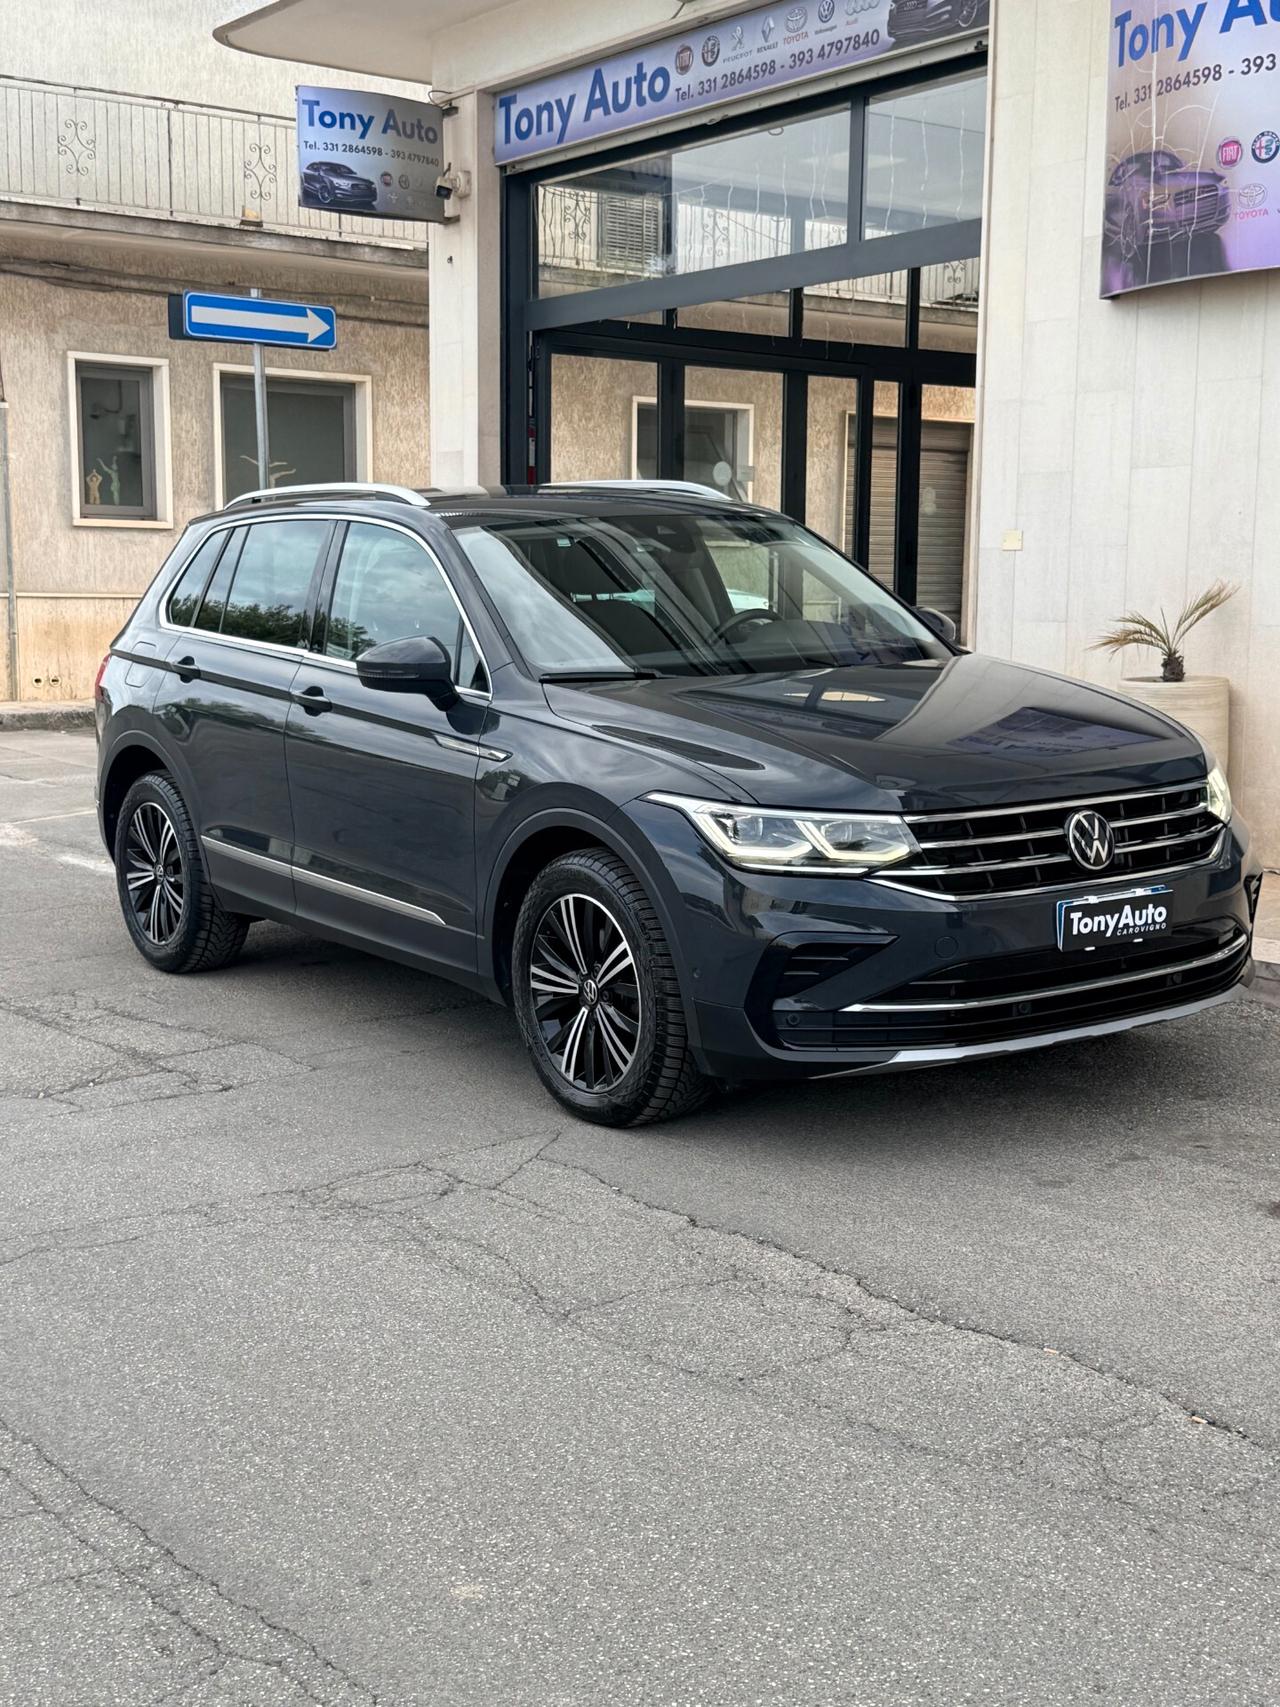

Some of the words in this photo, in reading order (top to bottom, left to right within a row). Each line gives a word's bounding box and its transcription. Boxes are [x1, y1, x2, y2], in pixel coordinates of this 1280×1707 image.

[783, 32, 809, 45] TOYOTA
[1114, 2, 1208, 68] Tony
[1219, 0, 1280, 34] A
[675, 85, 694, 102] Tel.
[698, 79, 717, 97] 331
[721, 60, 776, 89] 2864598
[789, 48, 813, 70] 393
[816, 29, 880, 60] 4797840
[1114, 91, 1131, 113] Tel.
[1134, 83, 1152, 105] 331
[1156, 64, 1222, 97] 2864598
[1241, 53, 1277, 76] 393
[499, 94, 576, 145] Tony
[583, 62, 671, 123] Auto
[302, 99, 375, 139] Tony
[381, 109, 438, 144] Auto
[304, 140, 320, 150] Tel.
[322, 142, 339, 152] 331
[342, 144, 383, 156] 2864598
[391, 149, 406, 160] 393
[1222, 145, 1239, 163] FIAT
[1235, 208, 1269, 220] TOYOTA
[1070, 904, 1167, 937] TonyAuto
[1117, 922, 1167, 936] CAROVIGNO
